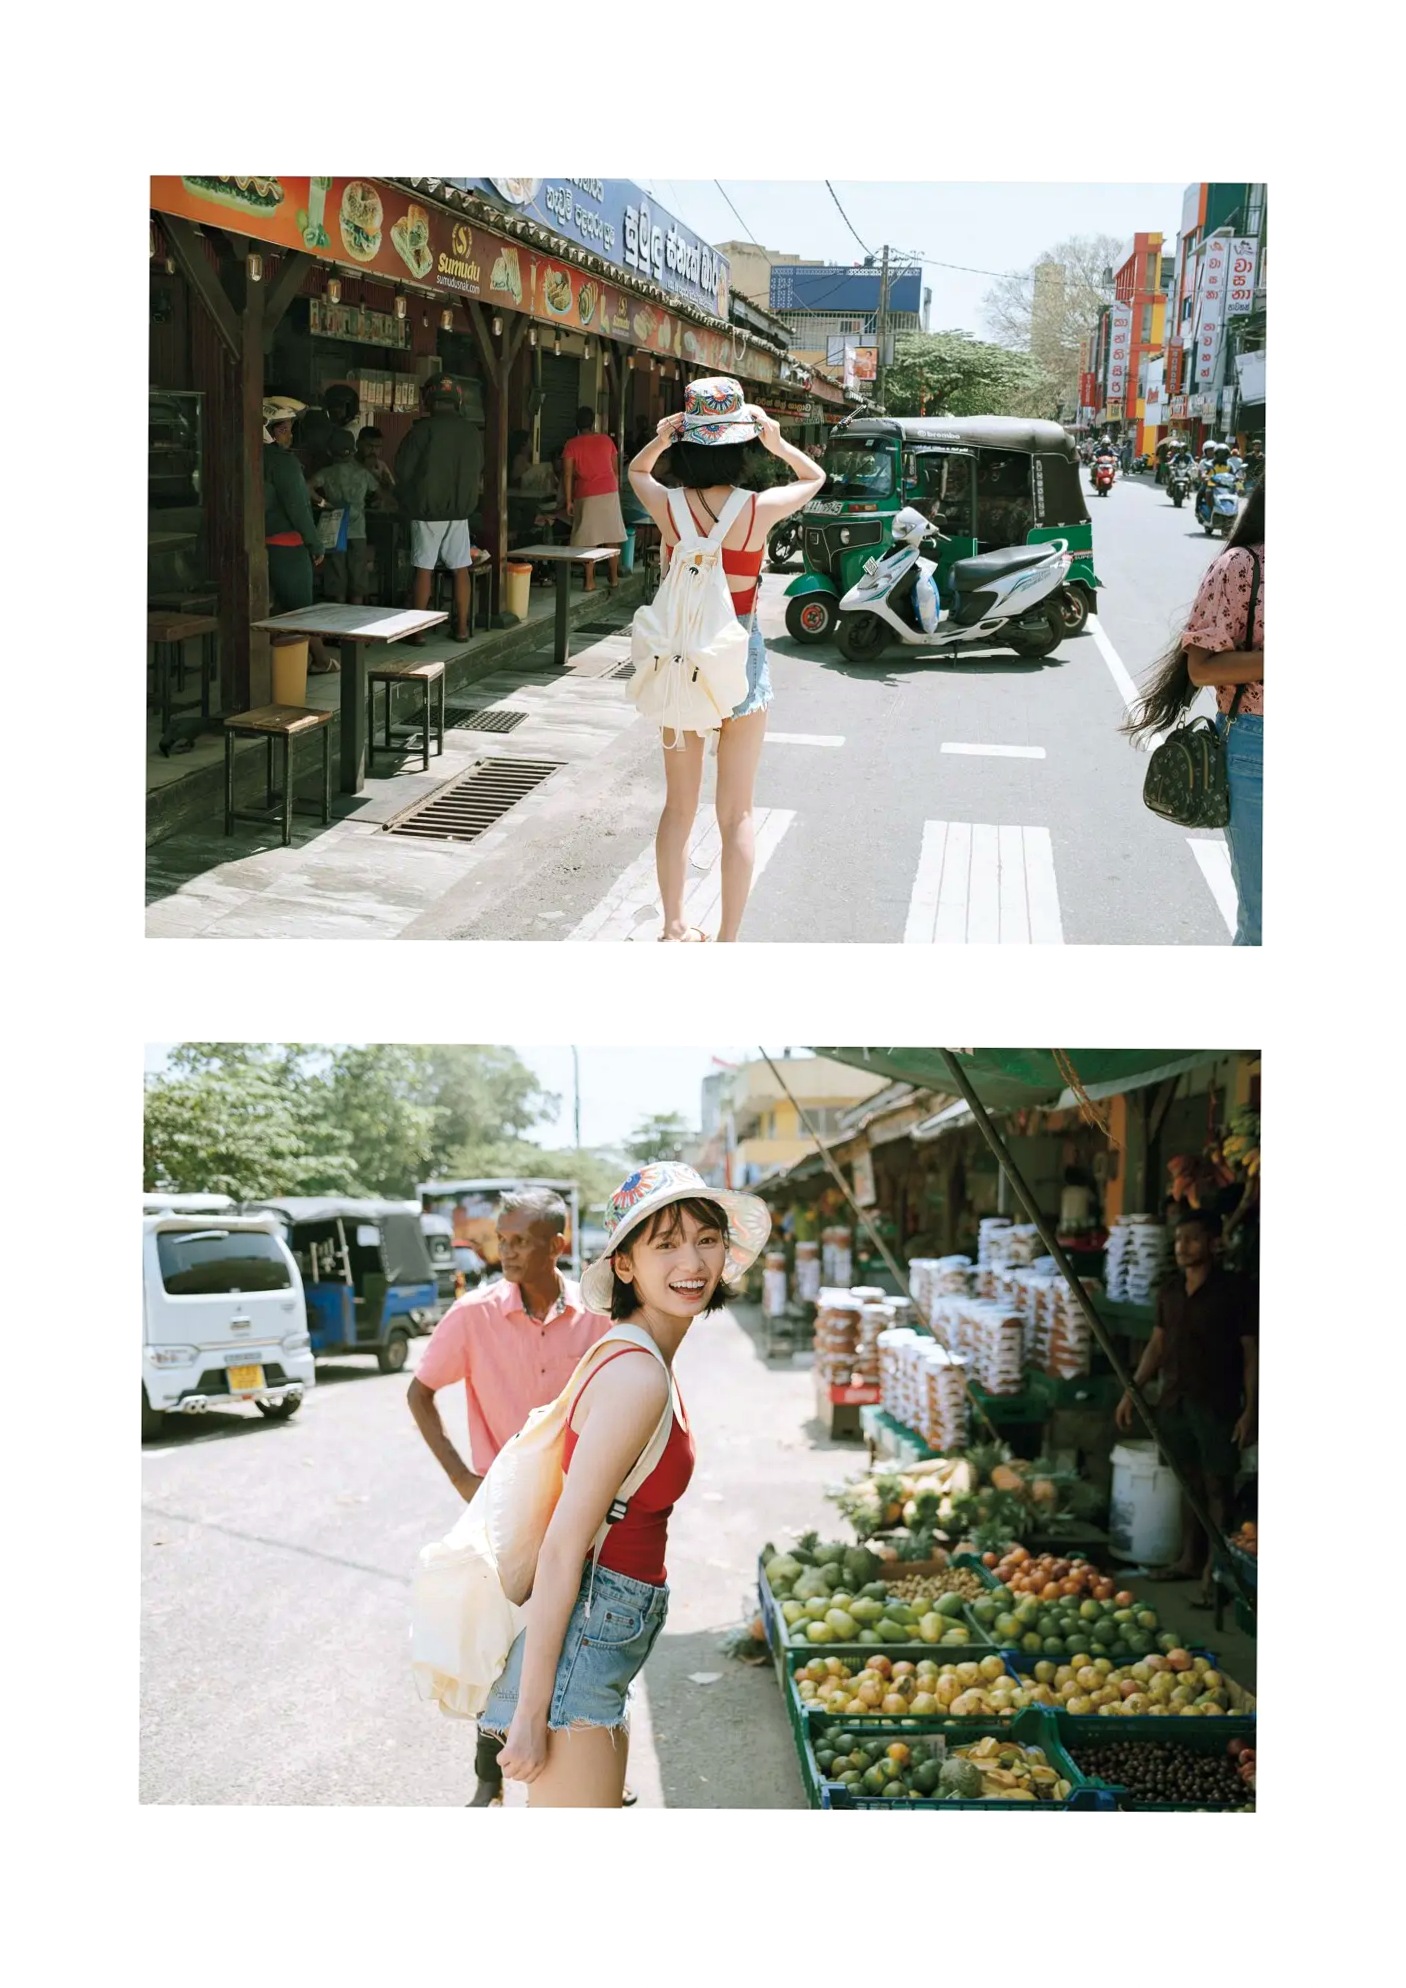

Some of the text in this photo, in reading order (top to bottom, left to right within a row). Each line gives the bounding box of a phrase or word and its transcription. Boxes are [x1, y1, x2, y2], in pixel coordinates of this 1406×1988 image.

[623, 202, 663, 281] සුමුදු
[1231, 258, 1253, 300] වාසනා
[926, 431, 961, 440] brembo
